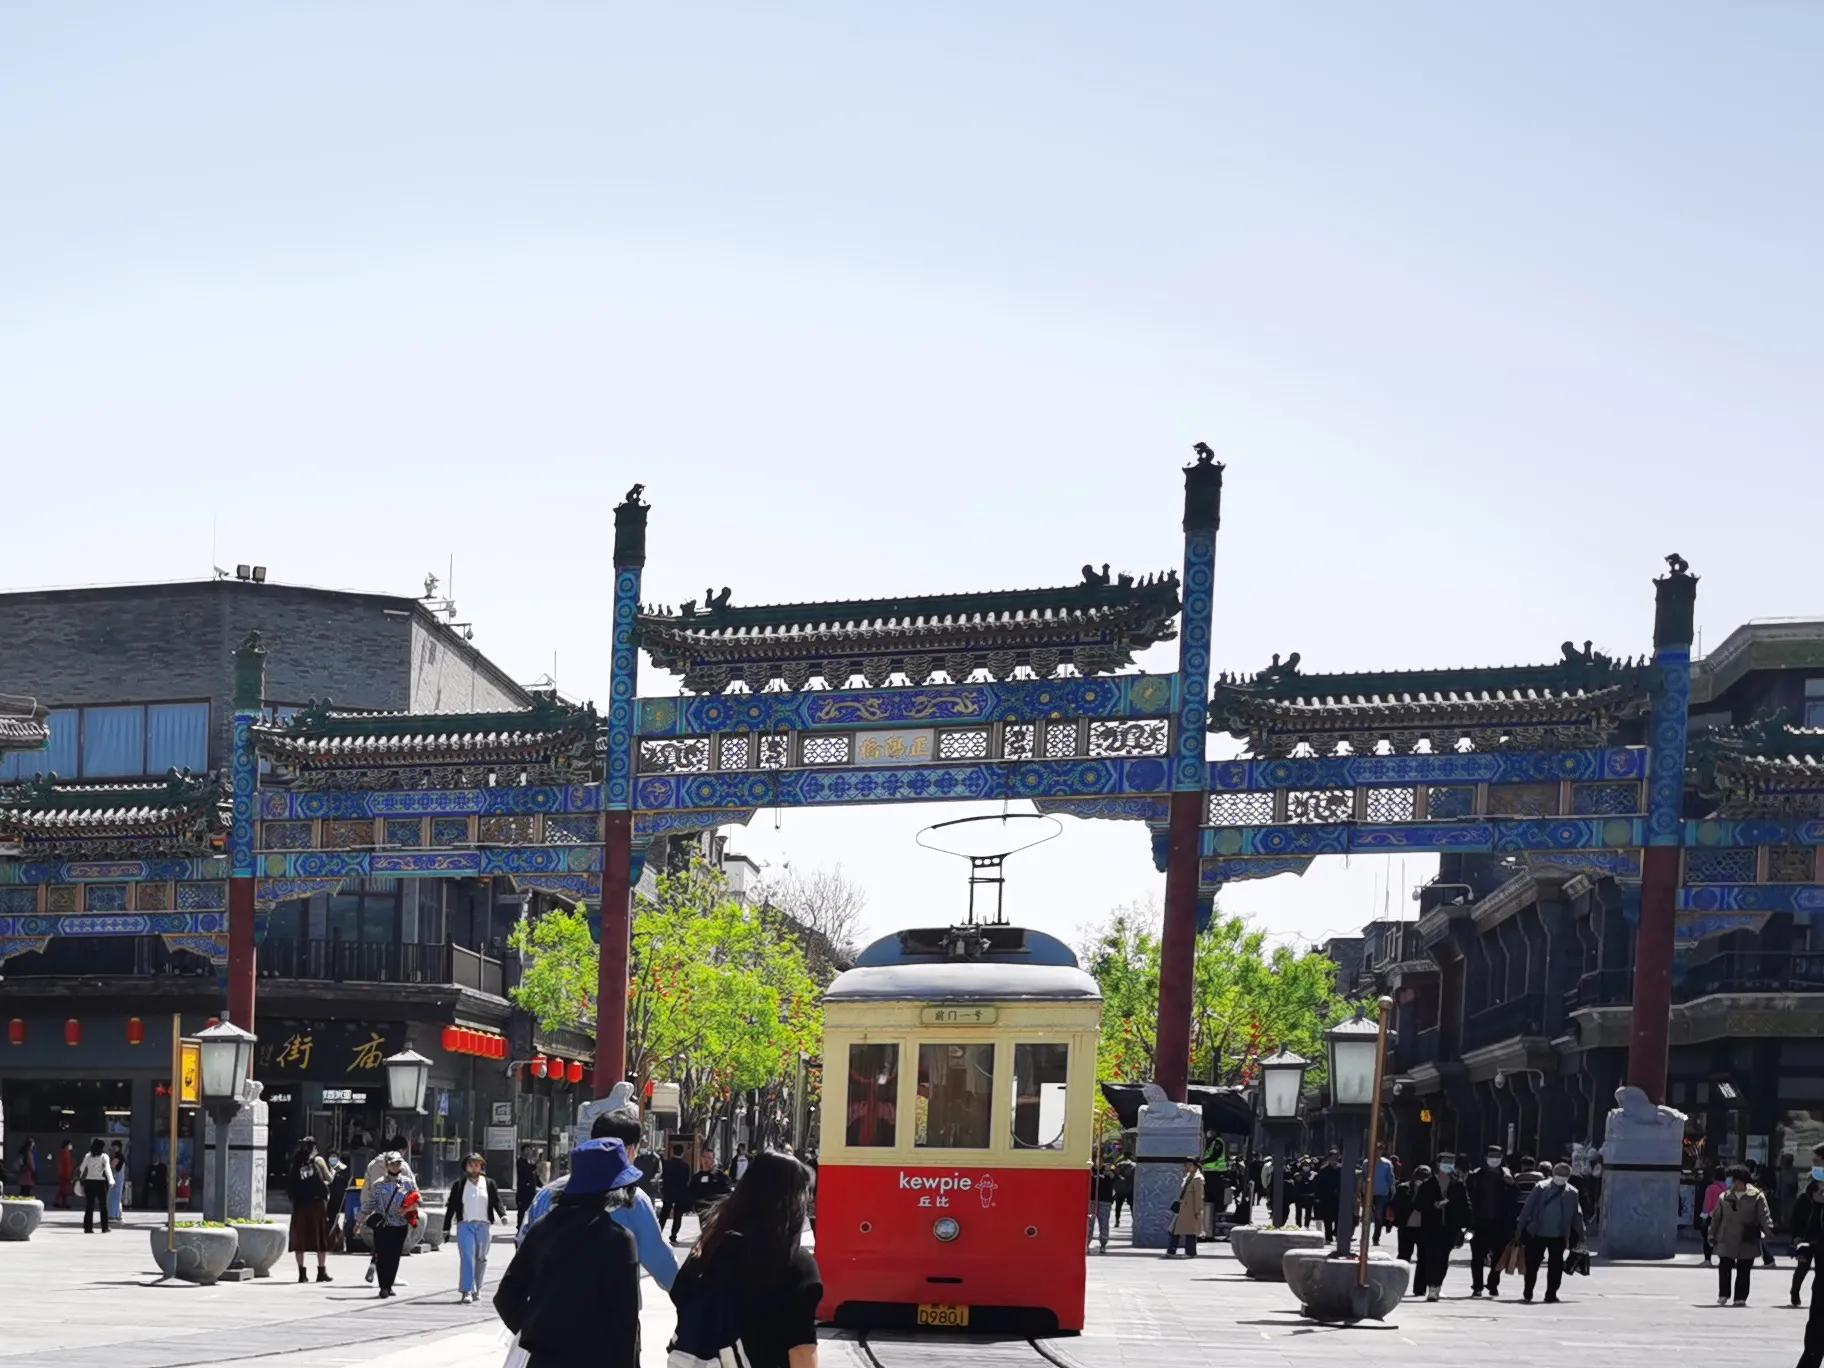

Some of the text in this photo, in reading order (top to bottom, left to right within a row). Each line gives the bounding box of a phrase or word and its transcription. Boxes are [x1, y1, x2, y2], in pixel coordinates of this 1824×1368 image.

[899, 1171, 972, 1195] kewpie
[917, 1196, 950, 1207] 丘比
[919, 1309, 964, 1325] D9801
